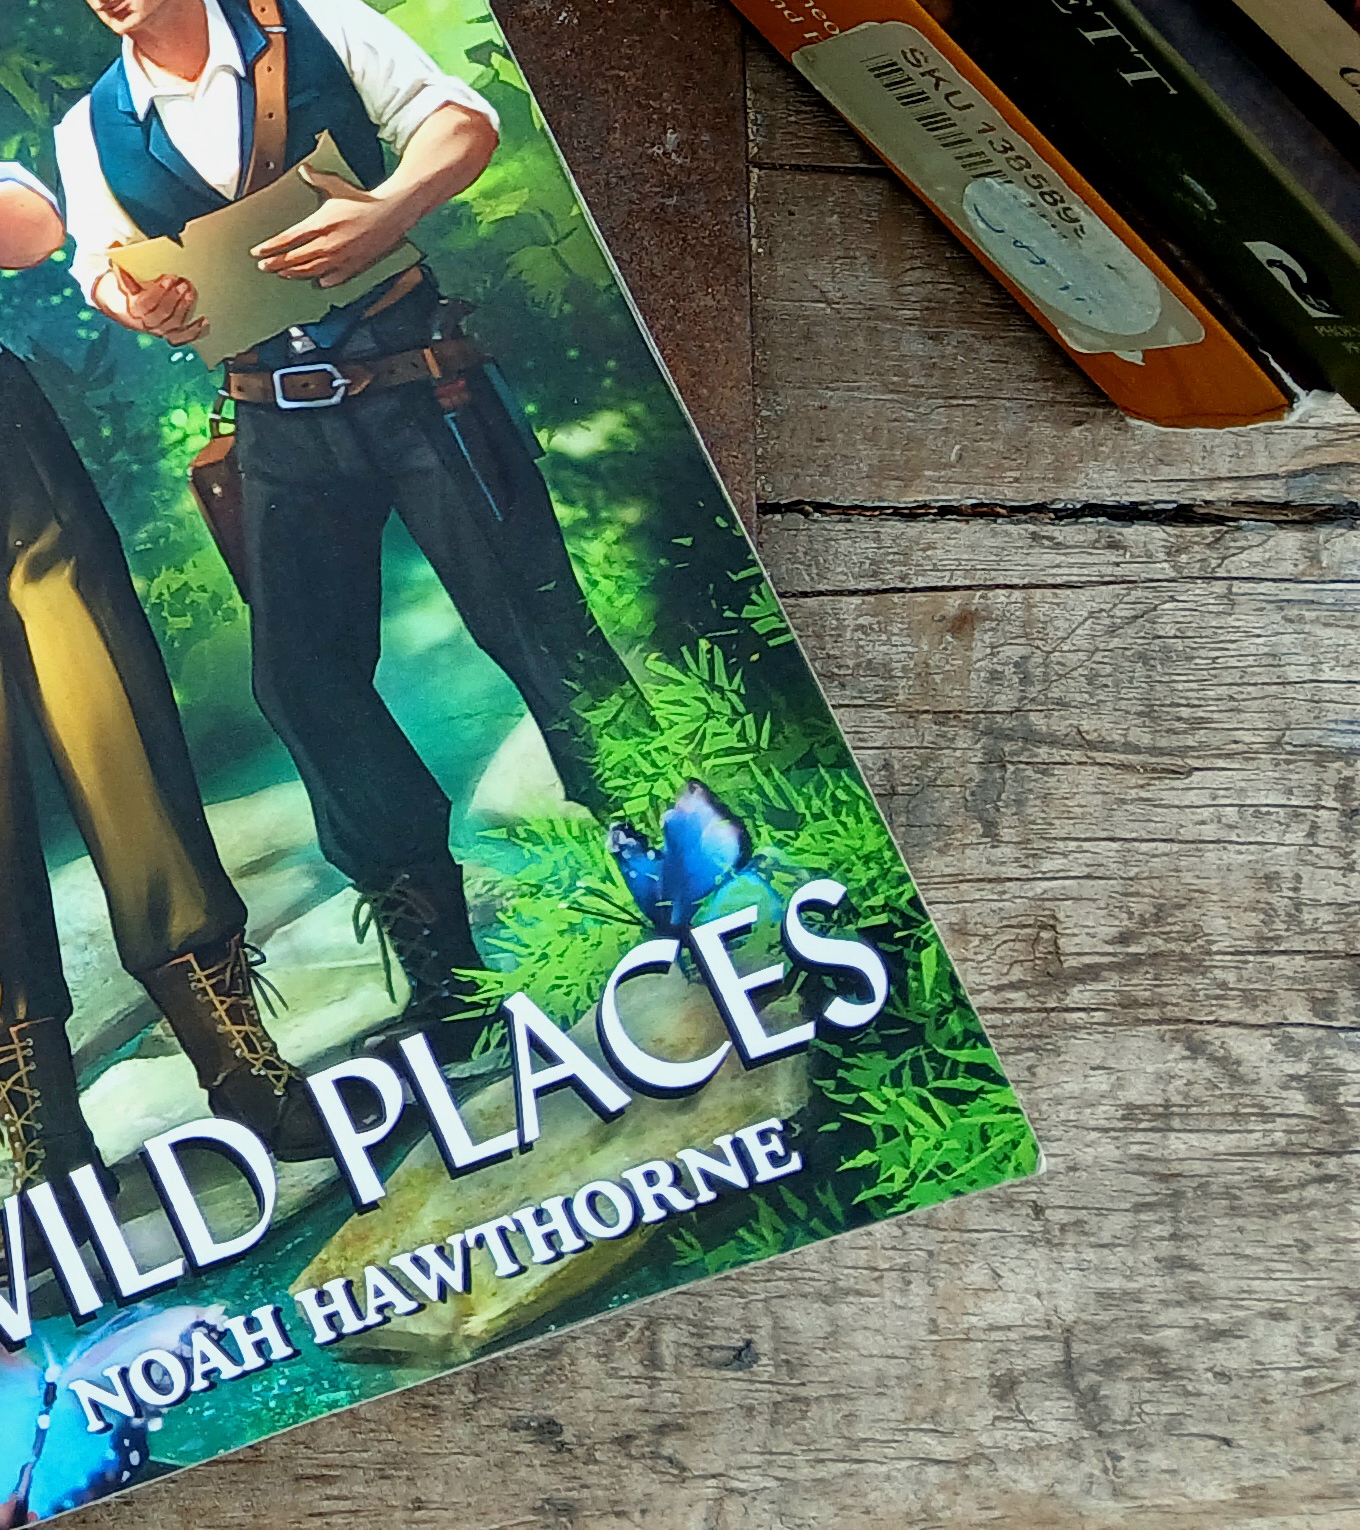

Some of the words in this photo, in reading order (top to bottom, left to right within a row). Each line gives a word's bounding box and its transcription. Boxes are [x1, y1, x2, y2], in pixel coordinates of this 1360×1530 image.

[900, 47, 976, 114] SKU
[303, 877, 892, 1212] PLACES
[70, 1303, 298, 1435] NOAH
[296, 1115, 806, 1347] HAWTHORNE
